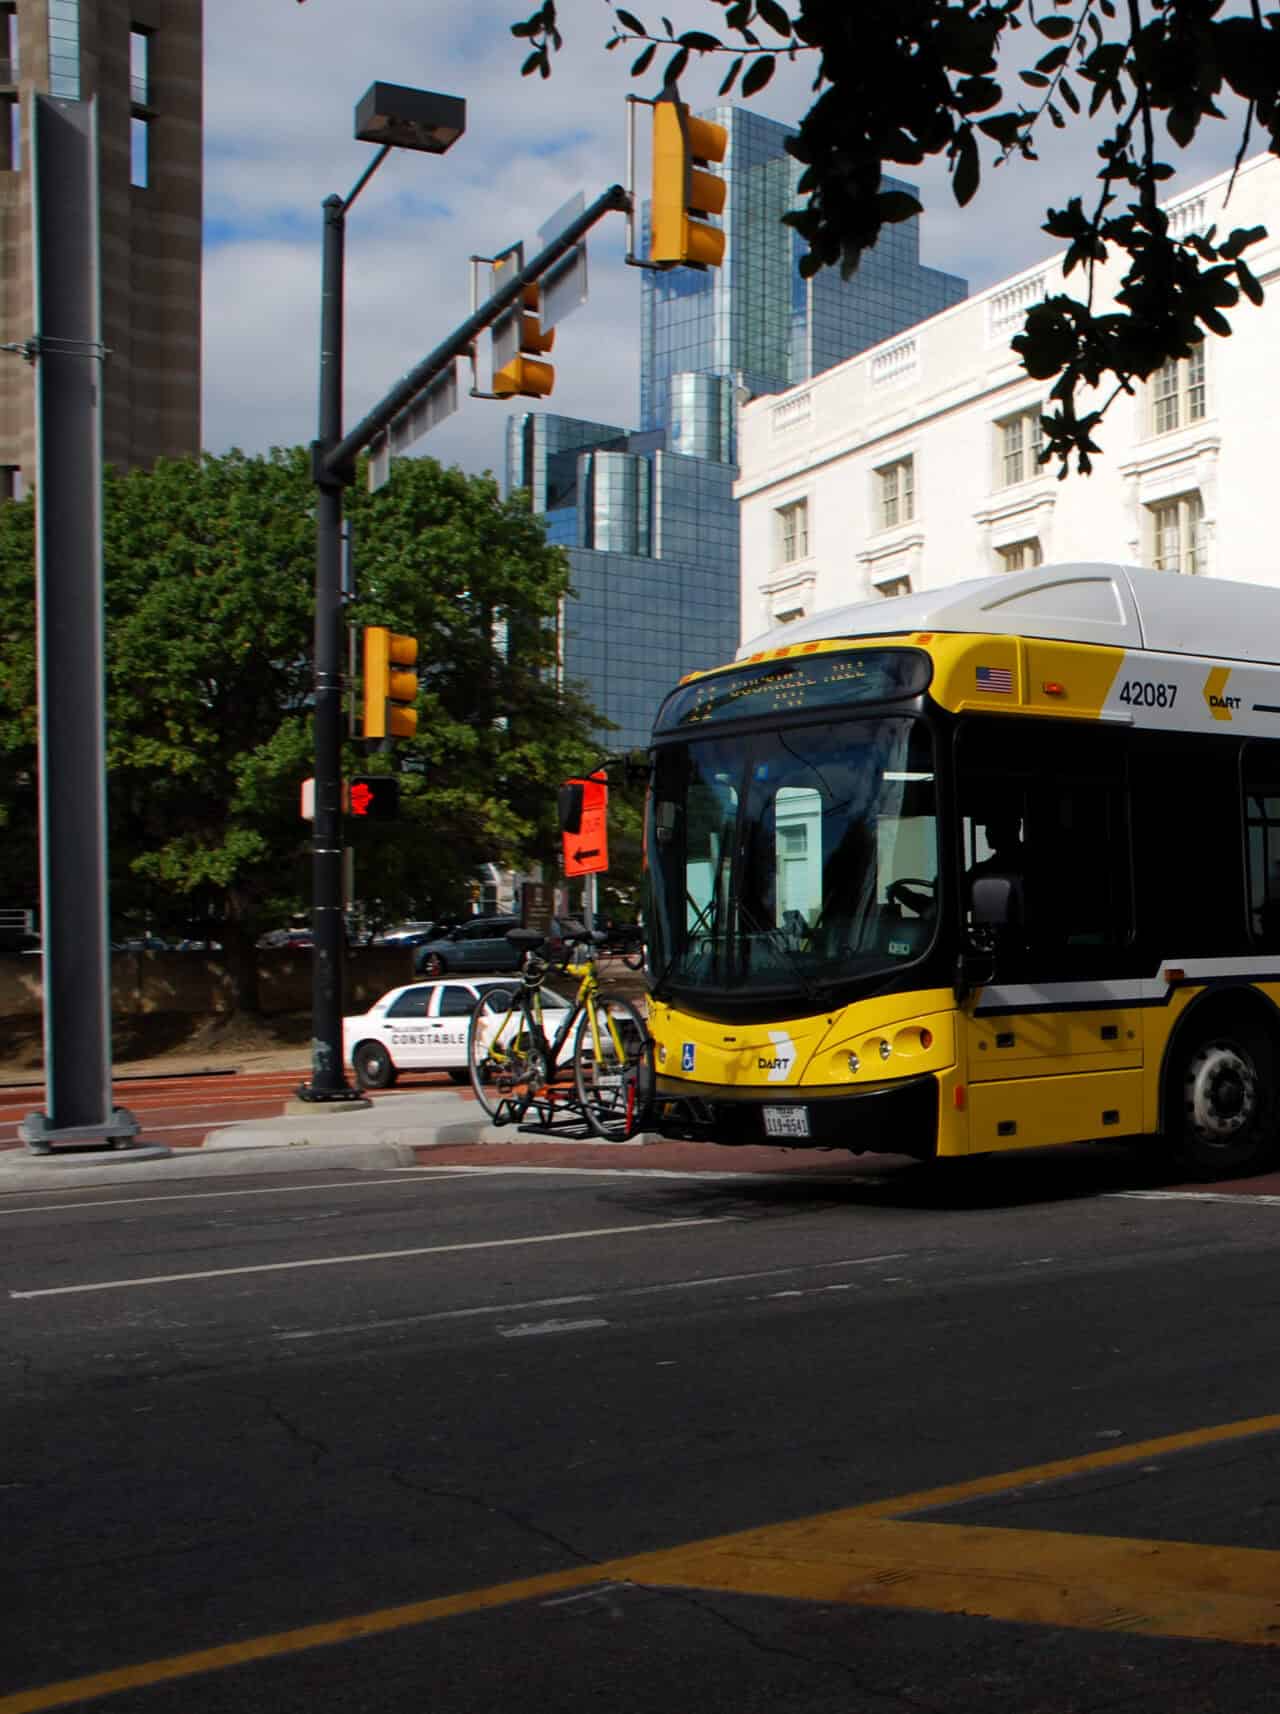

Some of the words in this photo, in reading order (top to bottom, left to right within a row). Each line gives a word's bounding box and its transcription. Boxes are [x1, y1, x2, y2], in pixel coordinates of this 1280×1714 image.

[1119, 681, 1177, 709] 42087
[1209, 695, 1241, 710] DART
[391, 1033, 465, 1045] CONSTABLE
[758, 1057, 790, 1070] DART
